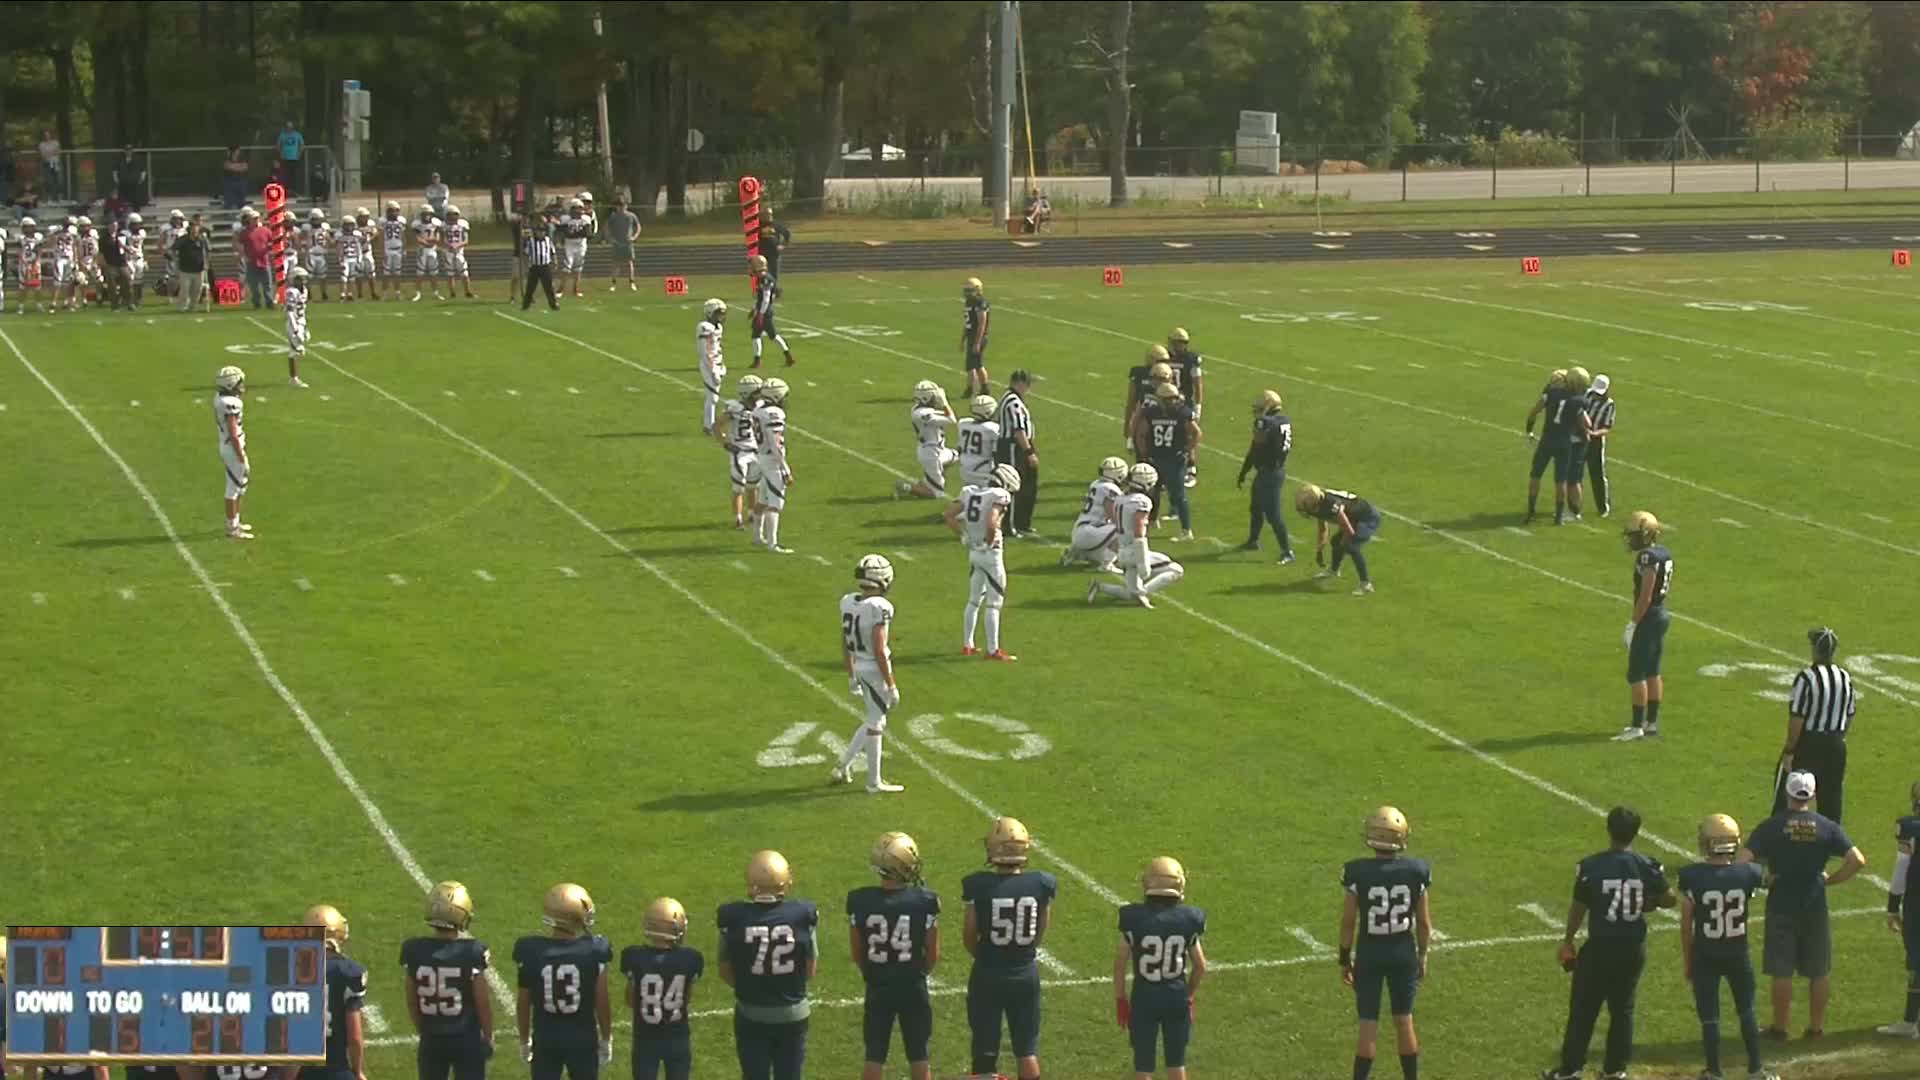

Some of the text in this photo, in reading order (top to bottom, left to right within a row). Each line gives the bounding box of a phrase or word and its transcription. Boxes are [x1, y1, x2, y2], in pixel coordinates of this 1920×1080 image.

[667, 279, 683, 293] 30
[1104, 269, 1121, 284] 20
[1525, 260, 1539, 273] 10
[221, 287, 238, 303] 40
[961, 429, 983, 455] 79
[1153, 425, 1174, 448] 64
[967, 495, 982, 522] 6
[842, 612, 866, 652] 21
[991, 897, 1038, 945] 50
[1368, 885, 1411, 935] 22
[1602, 879, 1644, 922] 70
[1703, 889, 1746, 940] 32
[744, 925, 795, 975] 72
[866, 914, 912, 964] 24
[1139, 935, 1186, 982] 20
[416, 966, 463, 1016] 25
[541, 964, 581, 1014] 13
[639, 974, 686, 1025] 84
